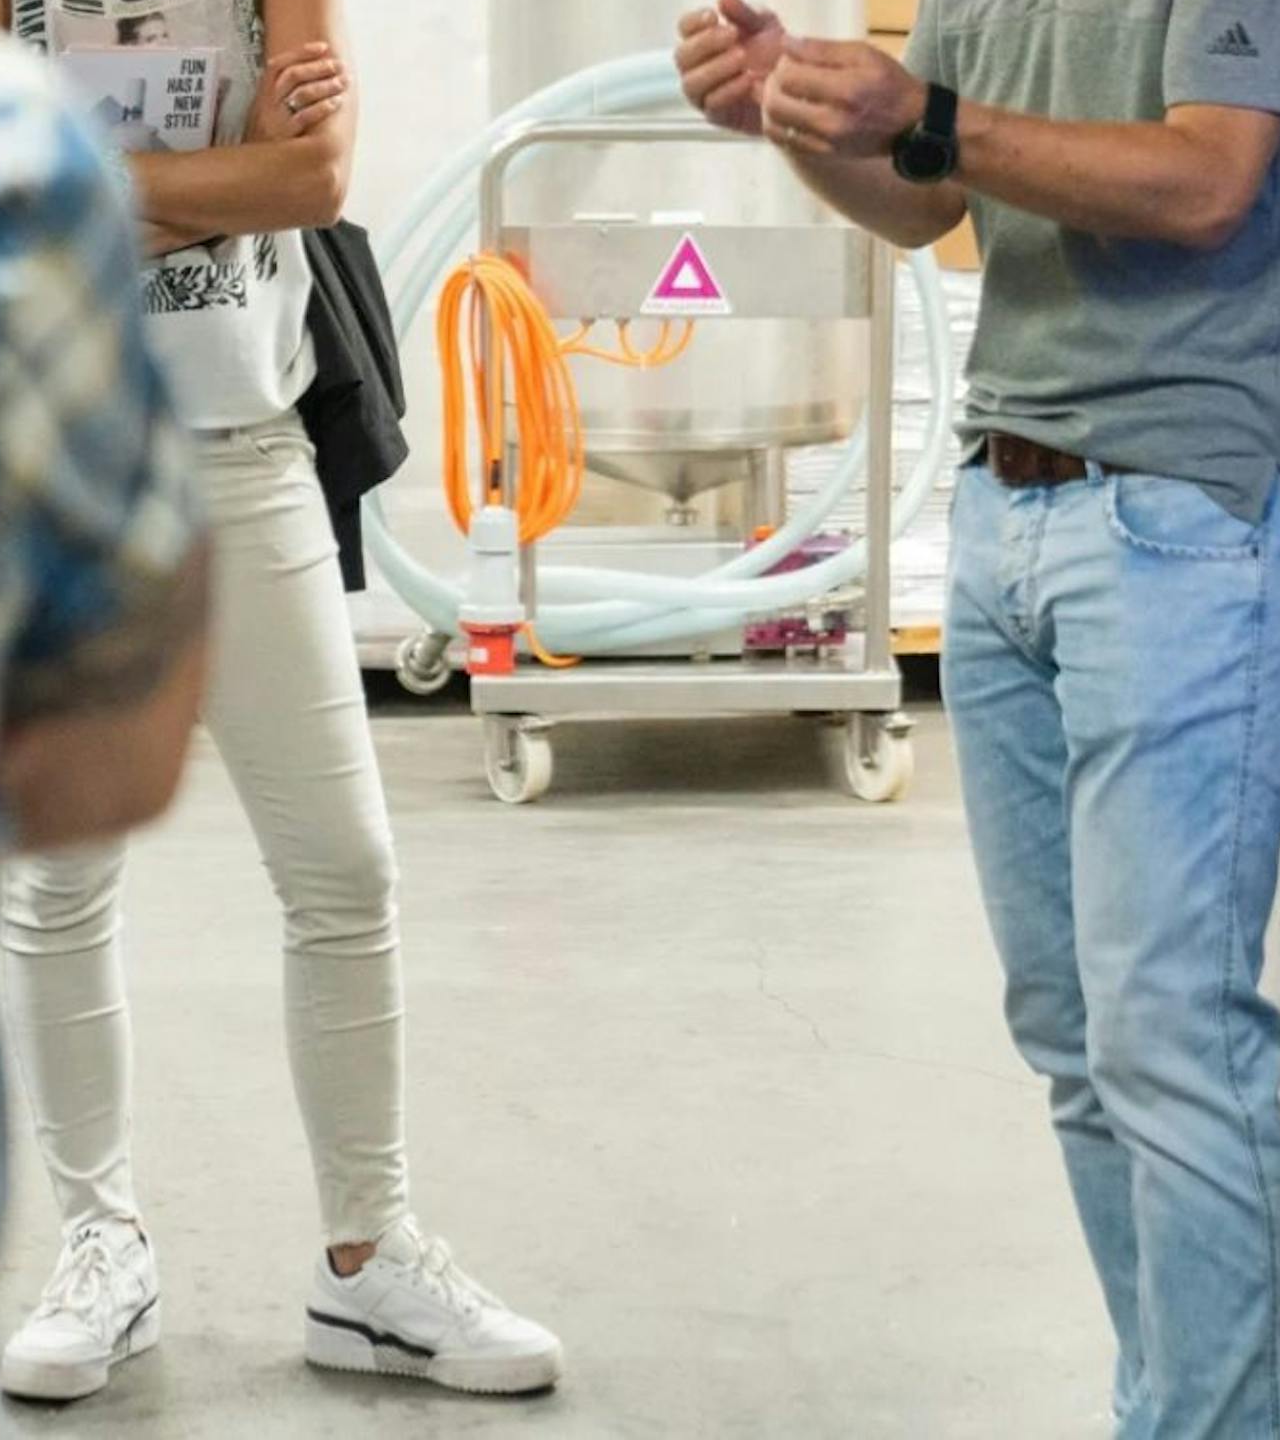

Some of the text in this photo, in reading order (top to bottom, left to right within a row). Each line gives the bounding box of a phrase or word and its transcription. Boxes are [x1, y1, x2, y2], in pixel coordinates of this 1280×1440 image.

[180, 59, 206, 75] FUN
[166, 77, 204, 94] HAS A
[173, 95, 203, 112] NEW
[164, 113, 200, 129] STYLE
